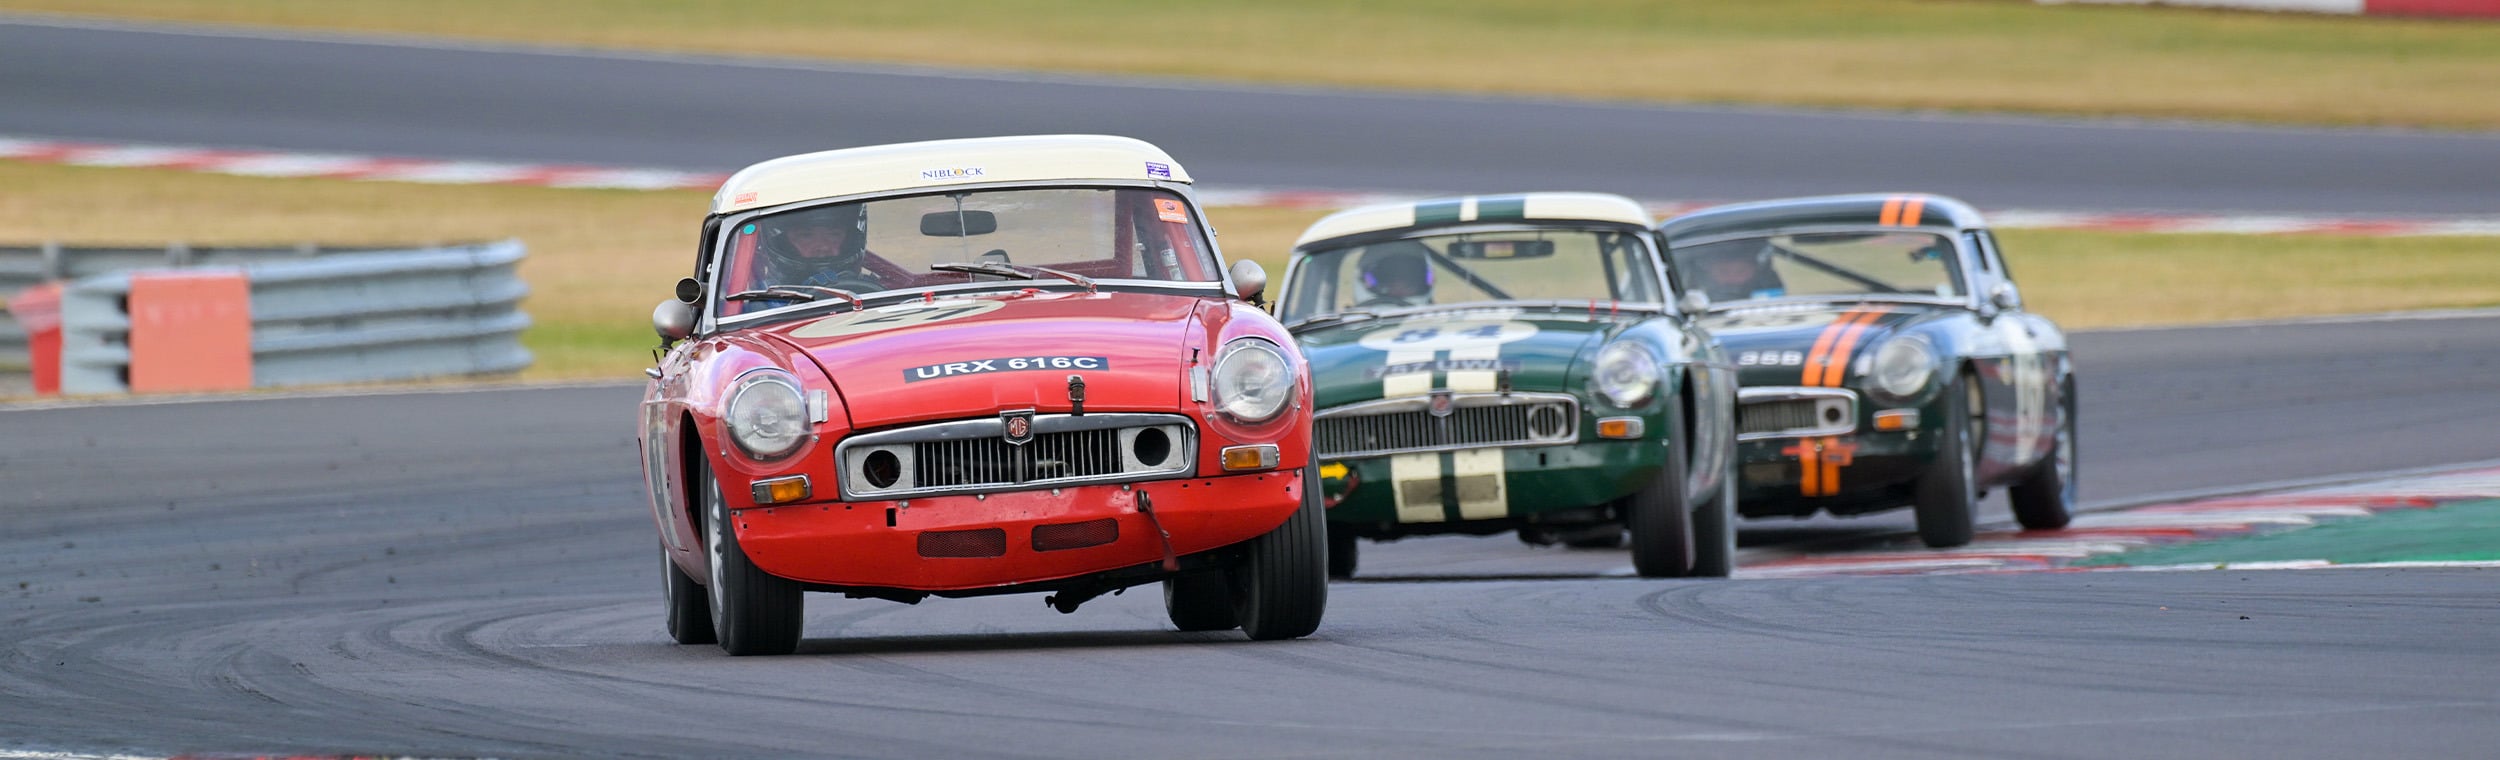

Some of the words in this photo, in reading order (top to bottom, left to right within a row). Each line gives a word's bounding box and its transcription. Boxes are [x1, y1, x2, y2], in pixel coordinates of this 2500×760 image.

[922, 167, 984, 179] NIBLOCK
[916, 359, 997, 379] URX
[1008, 357, 1099, 370] 616C
[1010, 419, 1027, 436] MG
